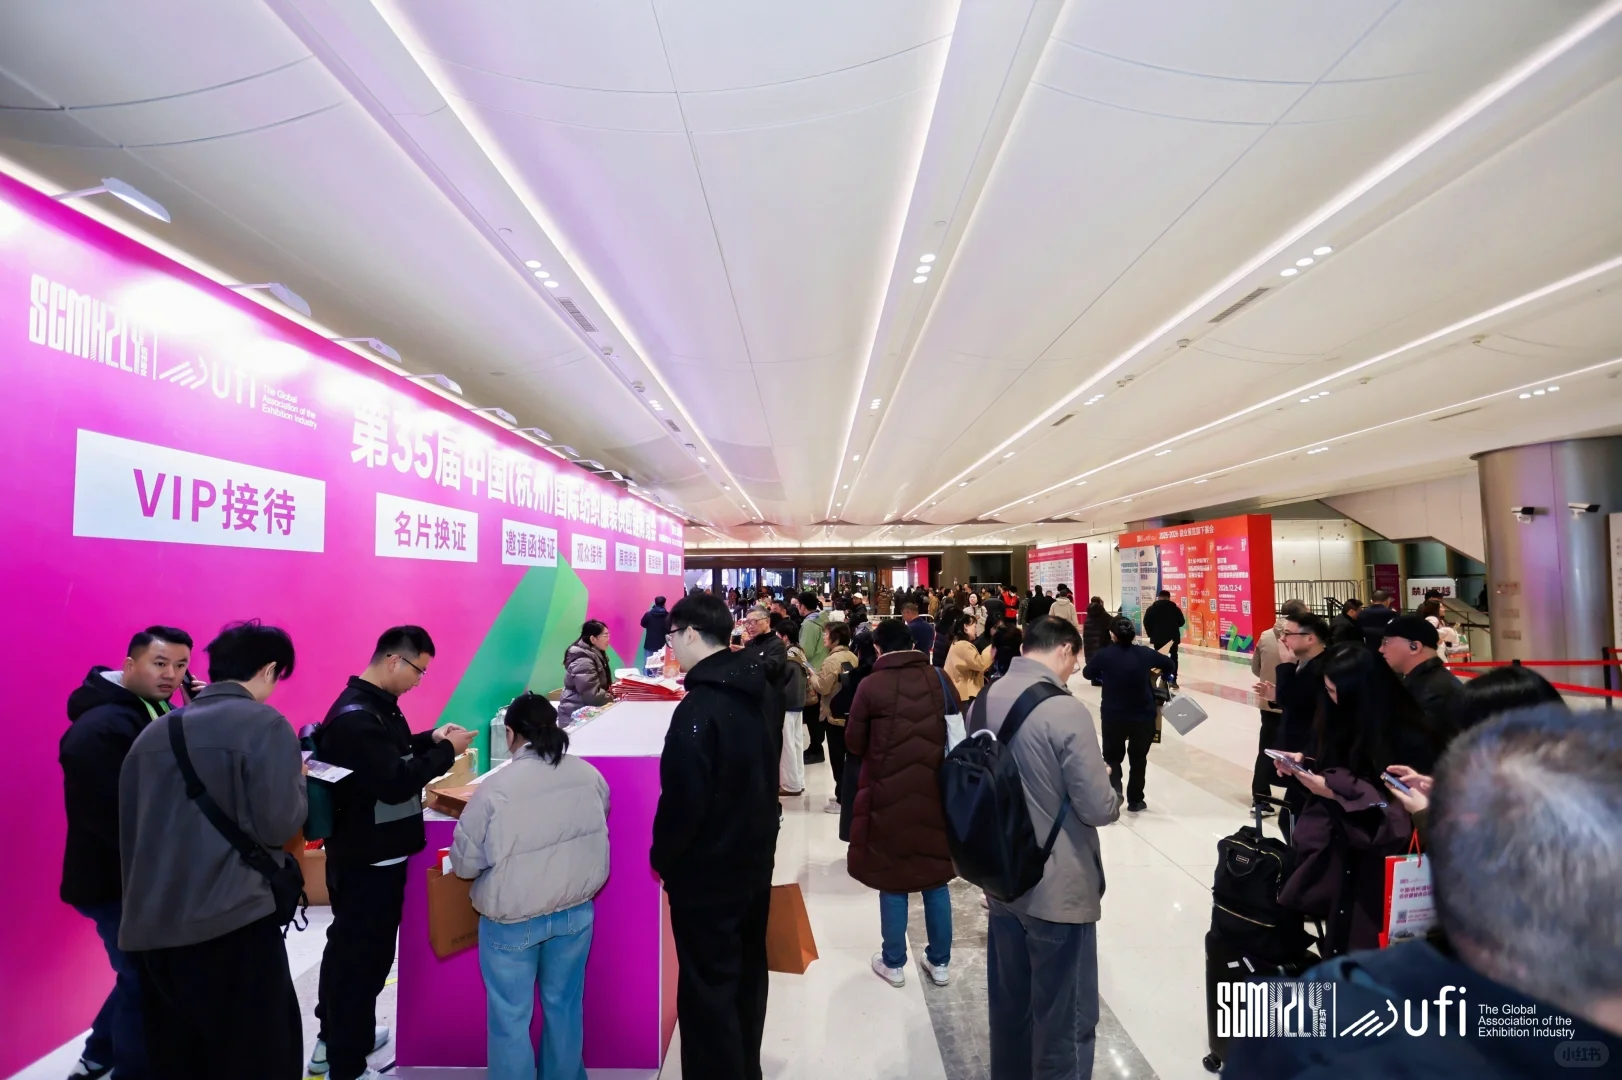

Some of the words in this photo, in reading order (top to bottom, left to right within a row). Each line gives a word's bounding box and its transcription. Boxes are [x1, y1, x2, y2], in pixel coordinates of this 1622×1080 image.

[262, 395, 298, 414] Association
[299, 404, 306, 415] of
[306, 406, 316, 419] the
[264, 384, 276, 397] The
[276, 388, 298, 404] Global
[262, 403, 293, 421] Exhibition
[294, 412, 318, 430] Industry
[133, 468, 296, 536] VIP接待
[394, 510, 467, 551] 名片换证
[505, 529, 556, 560] 邀请函换证
[576, 542, 603, 564] 观众接待
